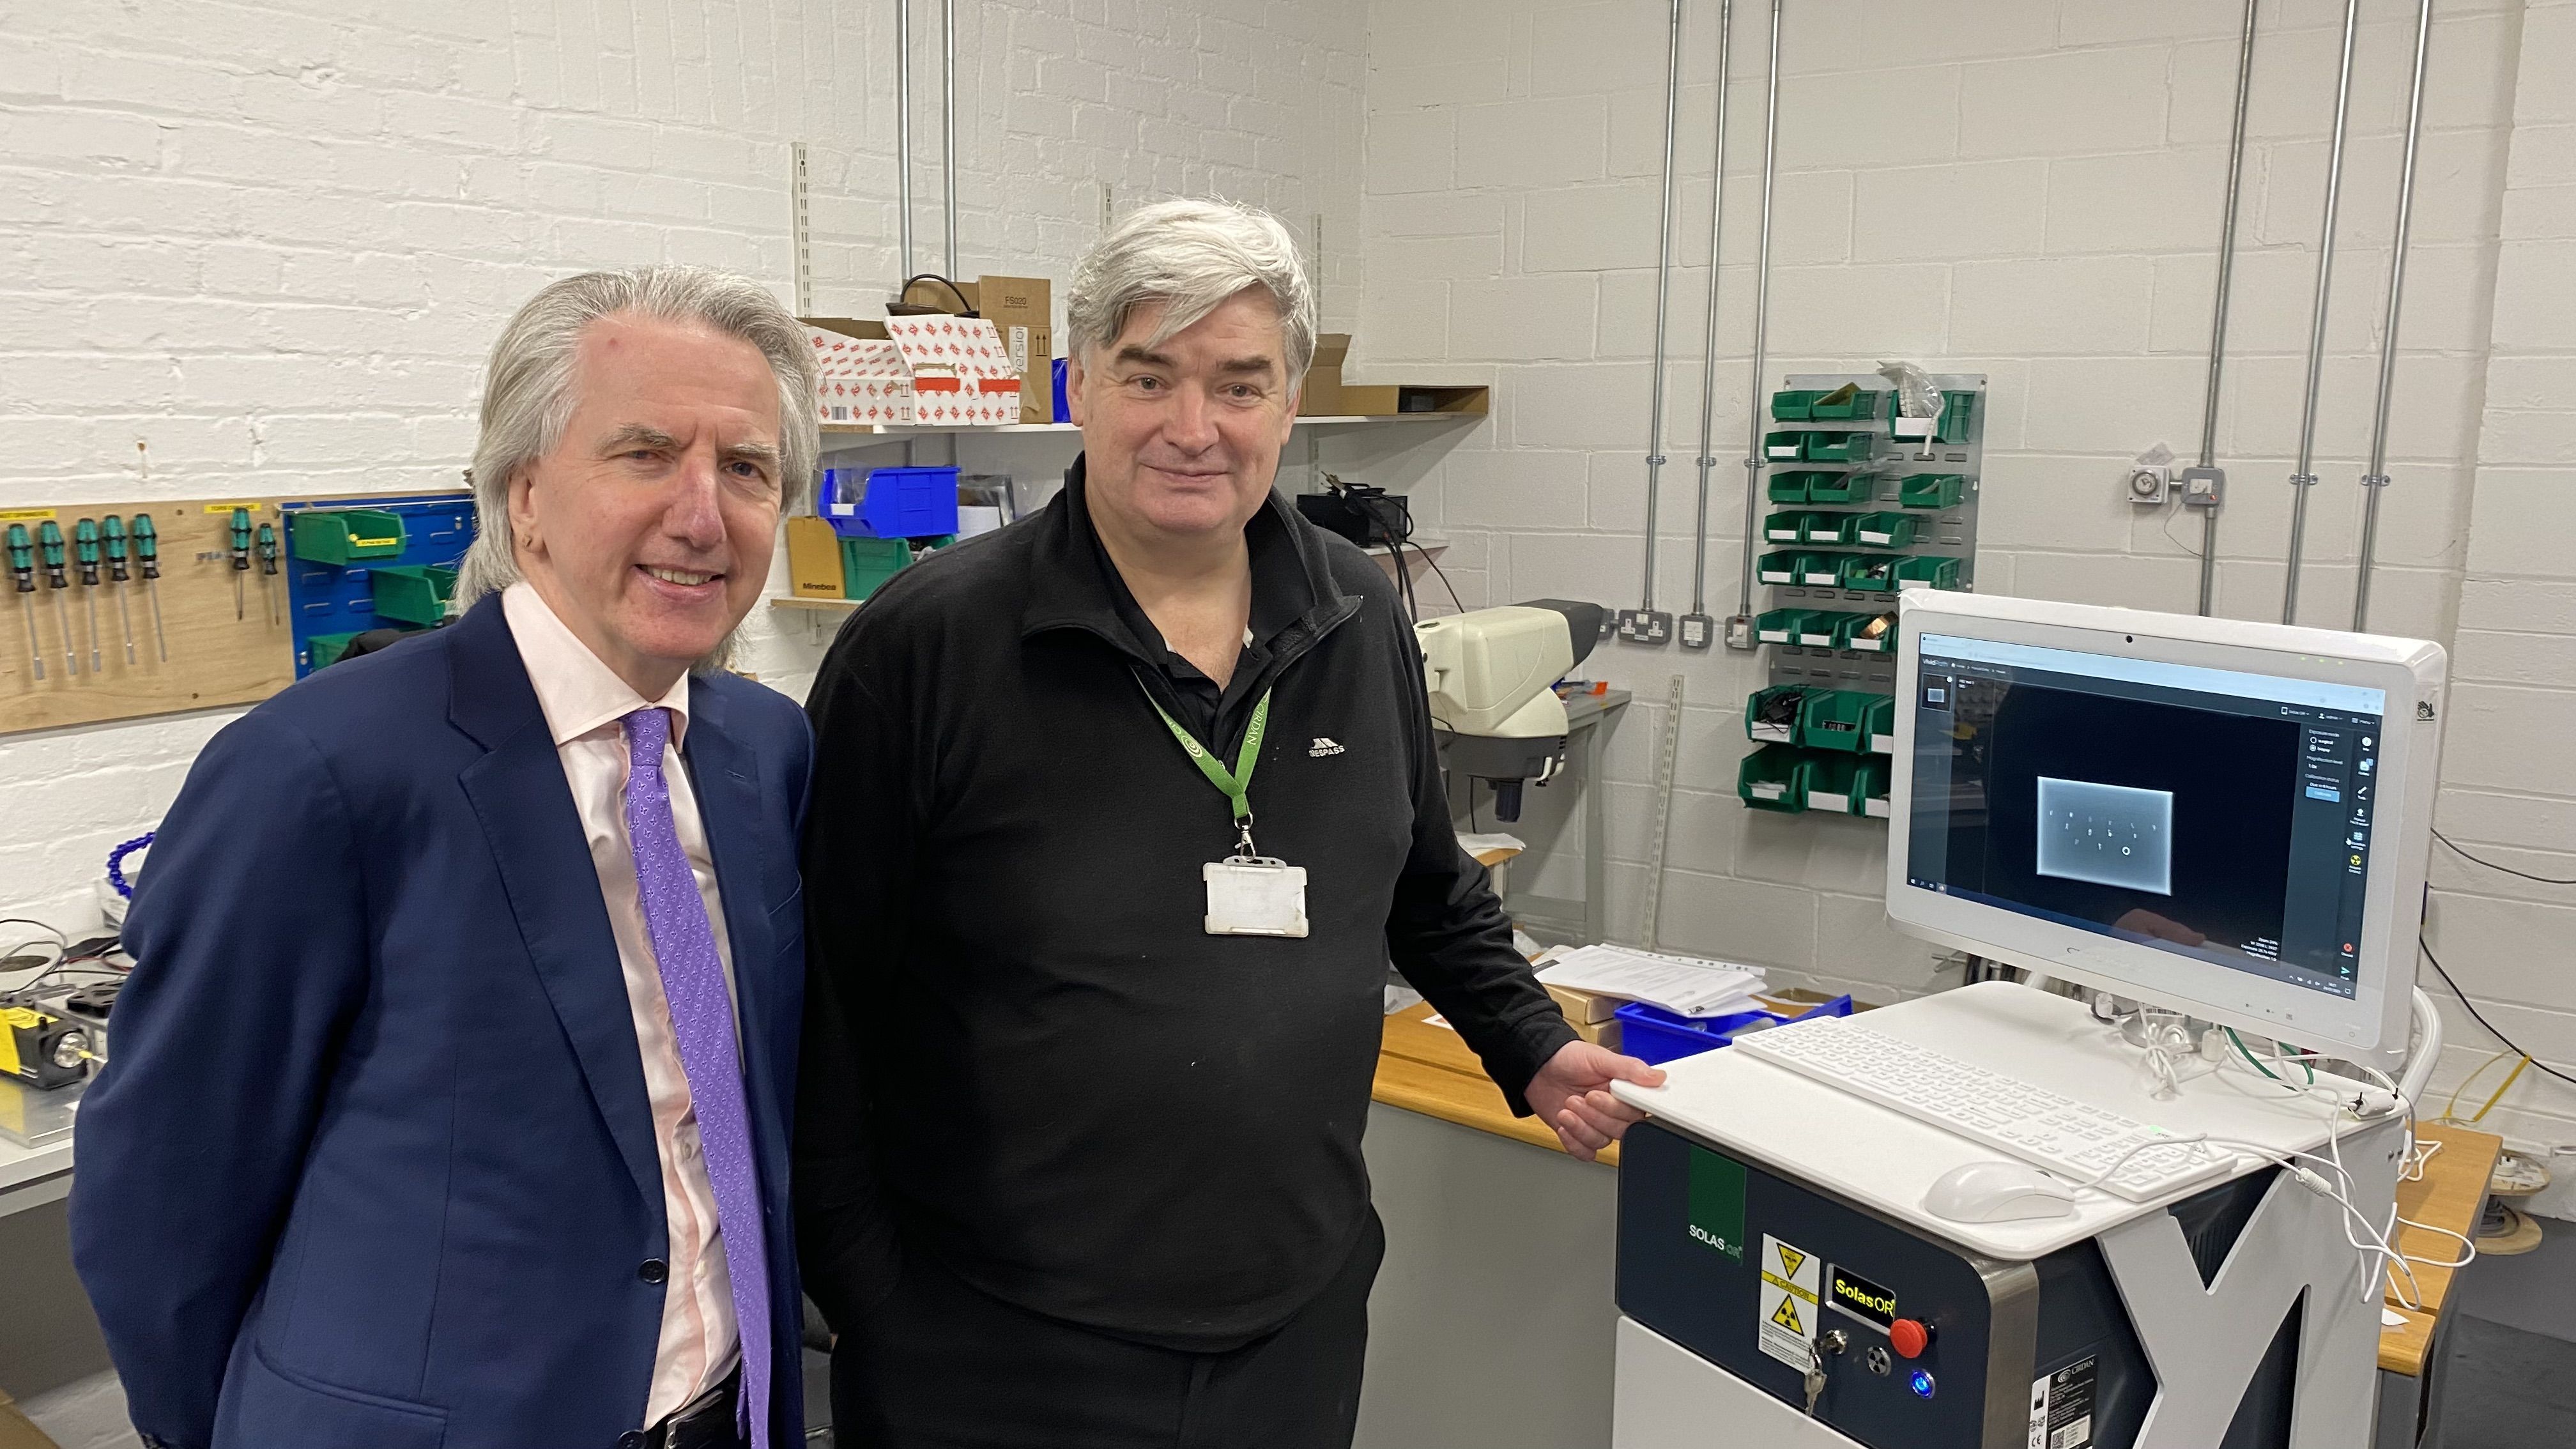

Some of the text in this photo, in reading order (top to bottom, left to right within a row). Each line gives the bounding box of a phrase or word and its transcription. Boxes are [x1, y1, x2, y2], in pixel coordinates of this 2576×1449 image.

[1246, 703, 1264, 746] CIRDAN
[1689, 1224, 1725, 1250] SOLAS
[1780, 1280, 1809, 1300] CAUTION
